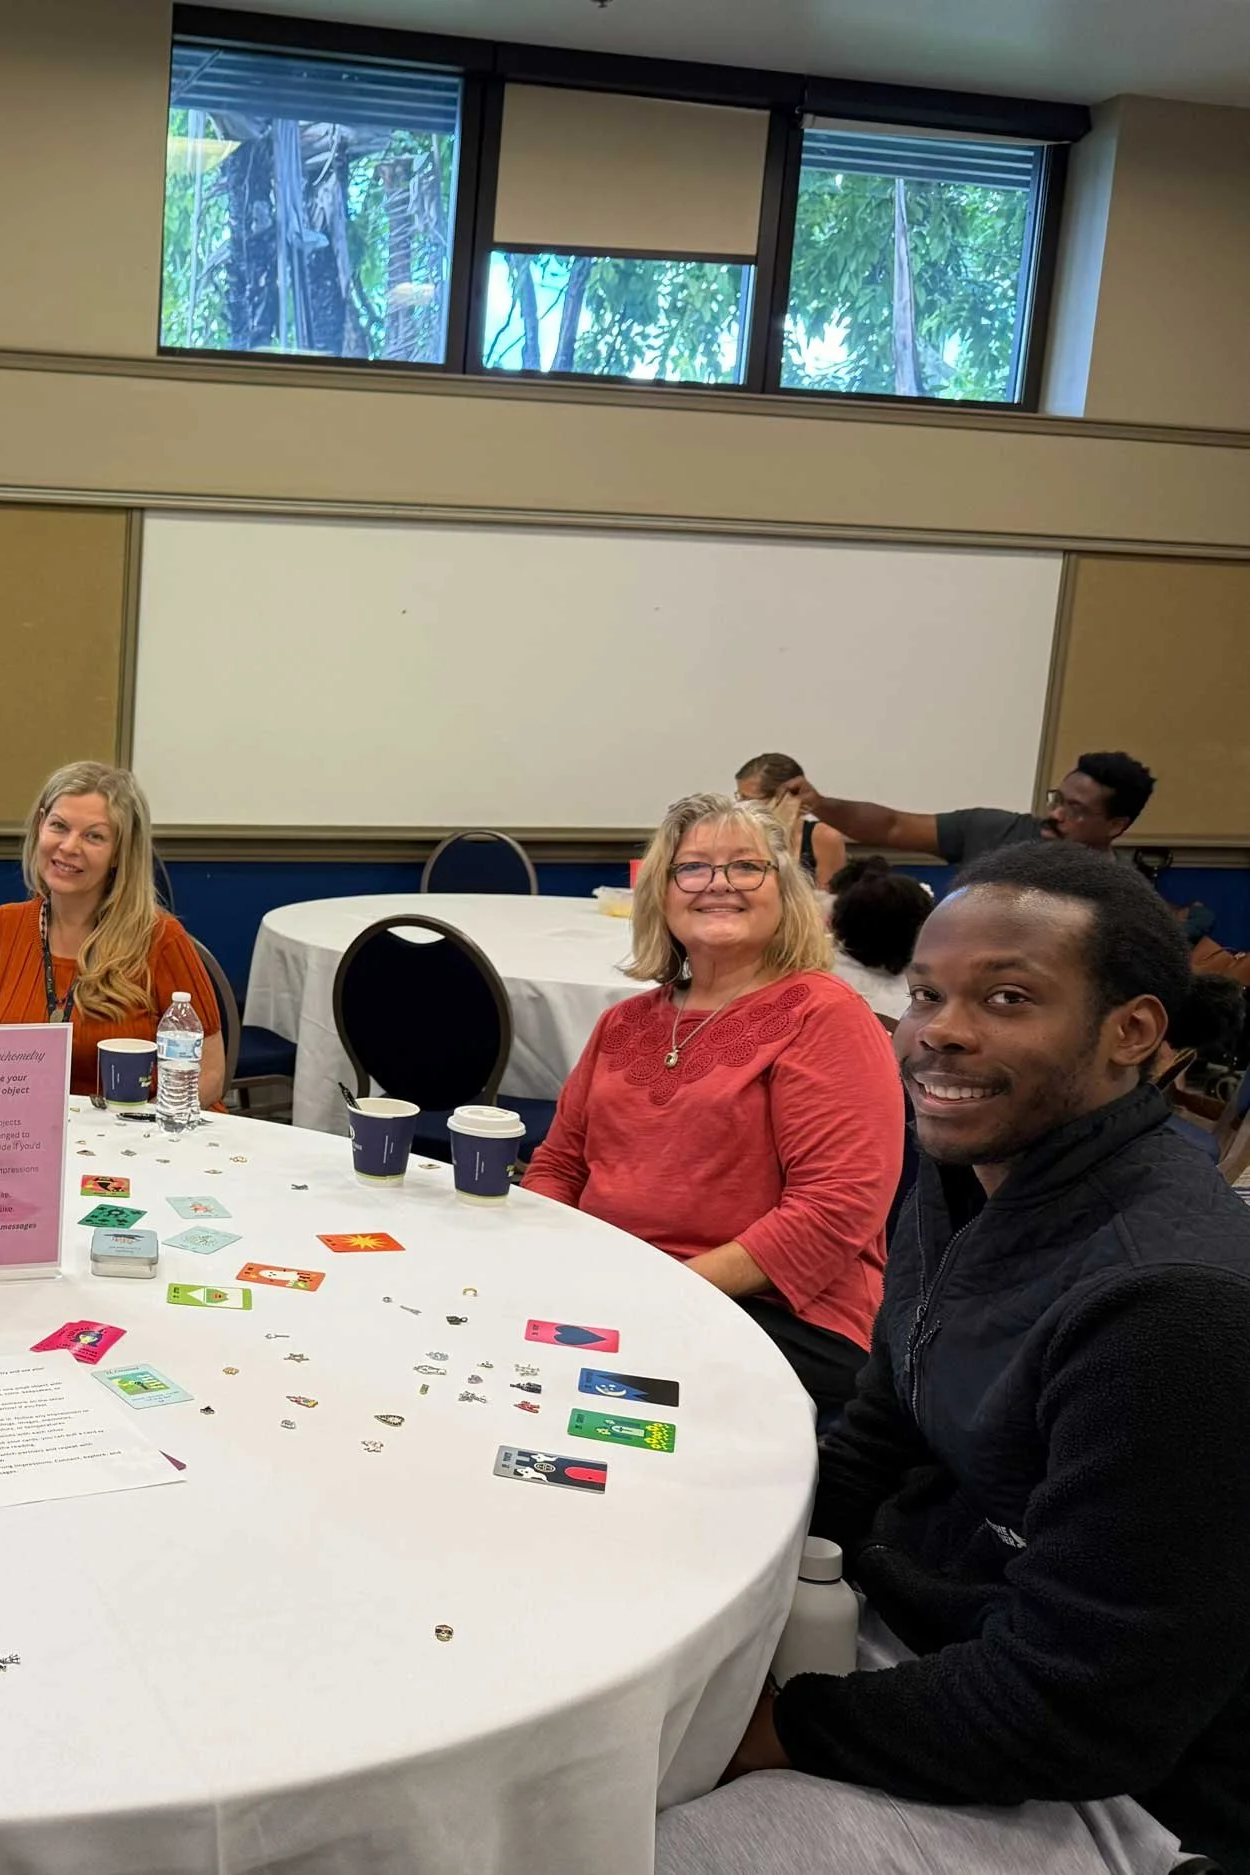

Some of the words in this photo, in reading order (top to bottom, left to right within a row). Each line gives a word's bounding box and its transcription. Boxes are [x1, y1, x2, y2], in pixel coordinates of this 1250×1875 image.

[6, 1075, 27, 1084] your
[2, 1086, 30, 1096] object
[22, 1131, 30, 1139] to
[20, 1142, 41, 1151] you'd
[0, 1223, 37, 1232] messages
